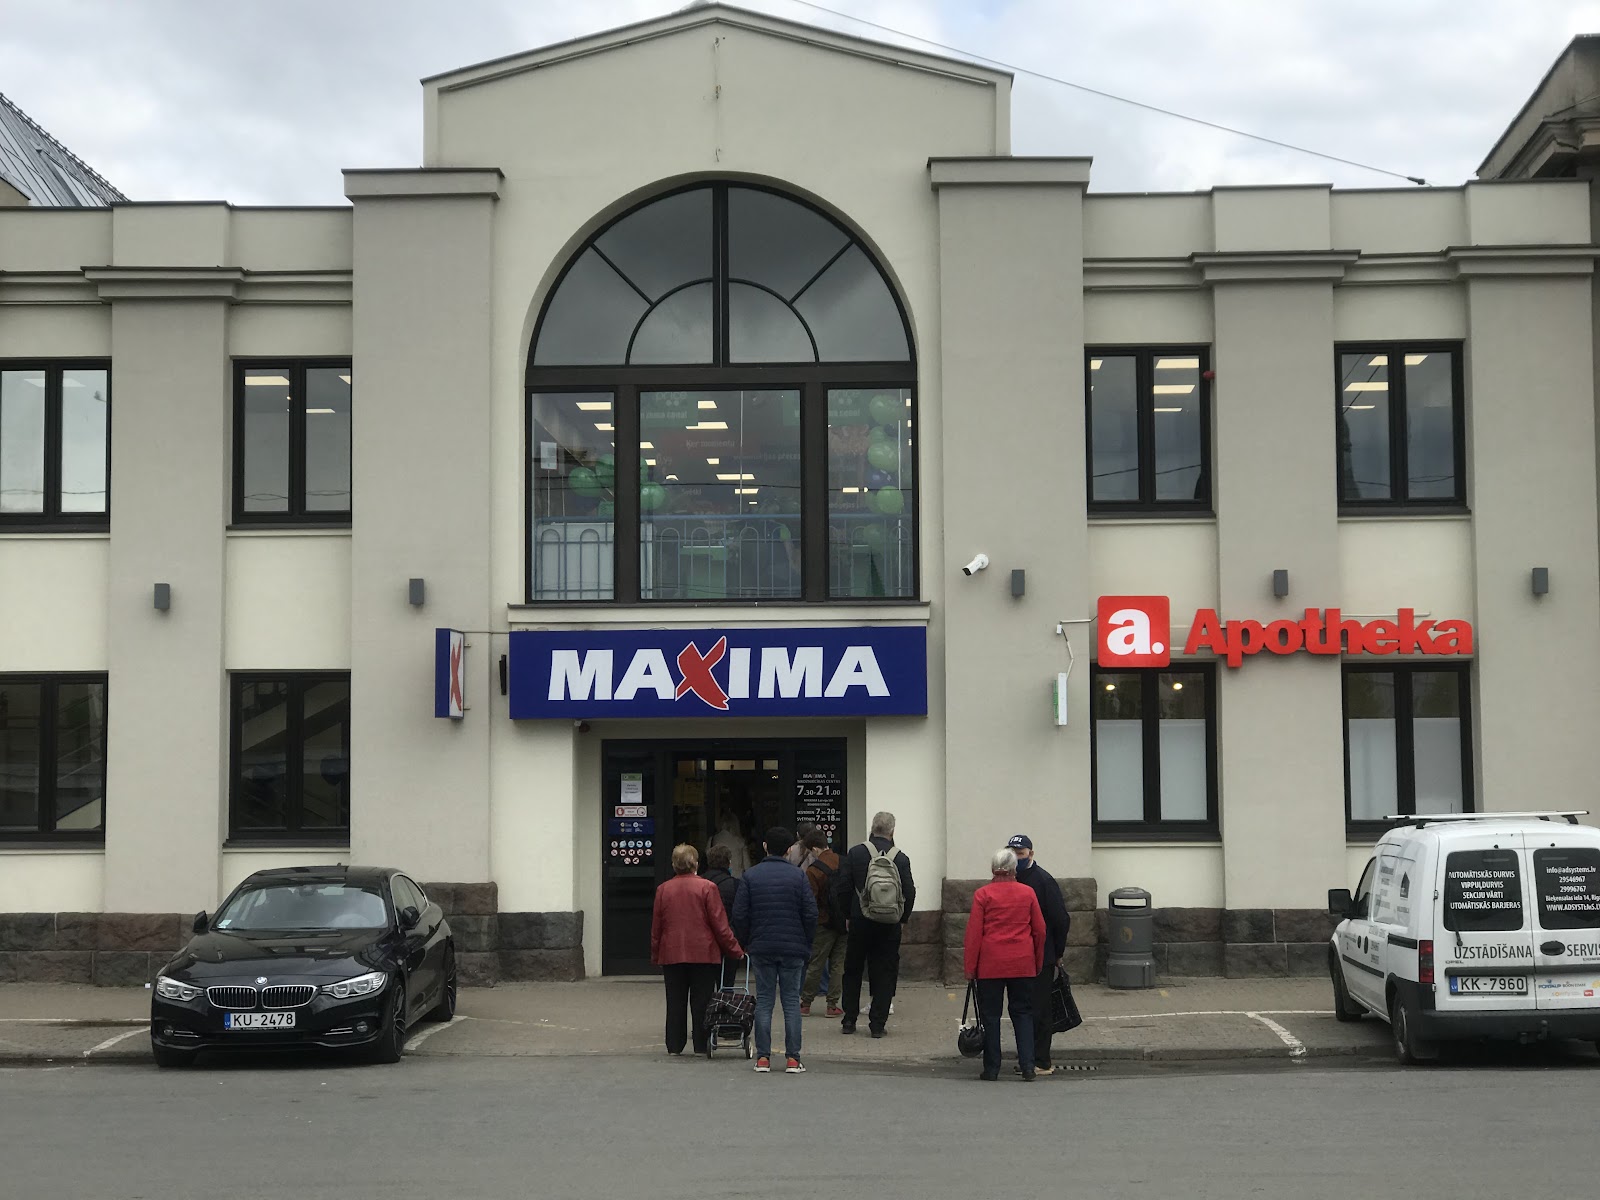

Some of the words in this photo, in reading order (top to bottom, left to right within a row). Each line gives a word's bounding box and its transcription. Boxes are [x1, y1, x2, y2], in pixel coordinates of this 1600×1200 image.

[1183, 607, 1474, 668] Apotheka
[547, 634, 891, 711] MAXIMA
[1493, 870, 1515, 878] DURVIS
[1546, 866, 1596, 875] info@adsystems.lv
[1486, 890, 1504, 899] VĀRTI
[1450, 901, 1491, 909] UTOMĀTISKĀS
[1492, 901, 1521, 909] BARJERAS
[1454, 943, 1533, 959] UZSTĀDĪŠANA
[1567, 943, 1600, 957] SERVI
[1460, 977, 1524, 991] KK-7960
[233, 1013, 293, 1027] KU-2478
